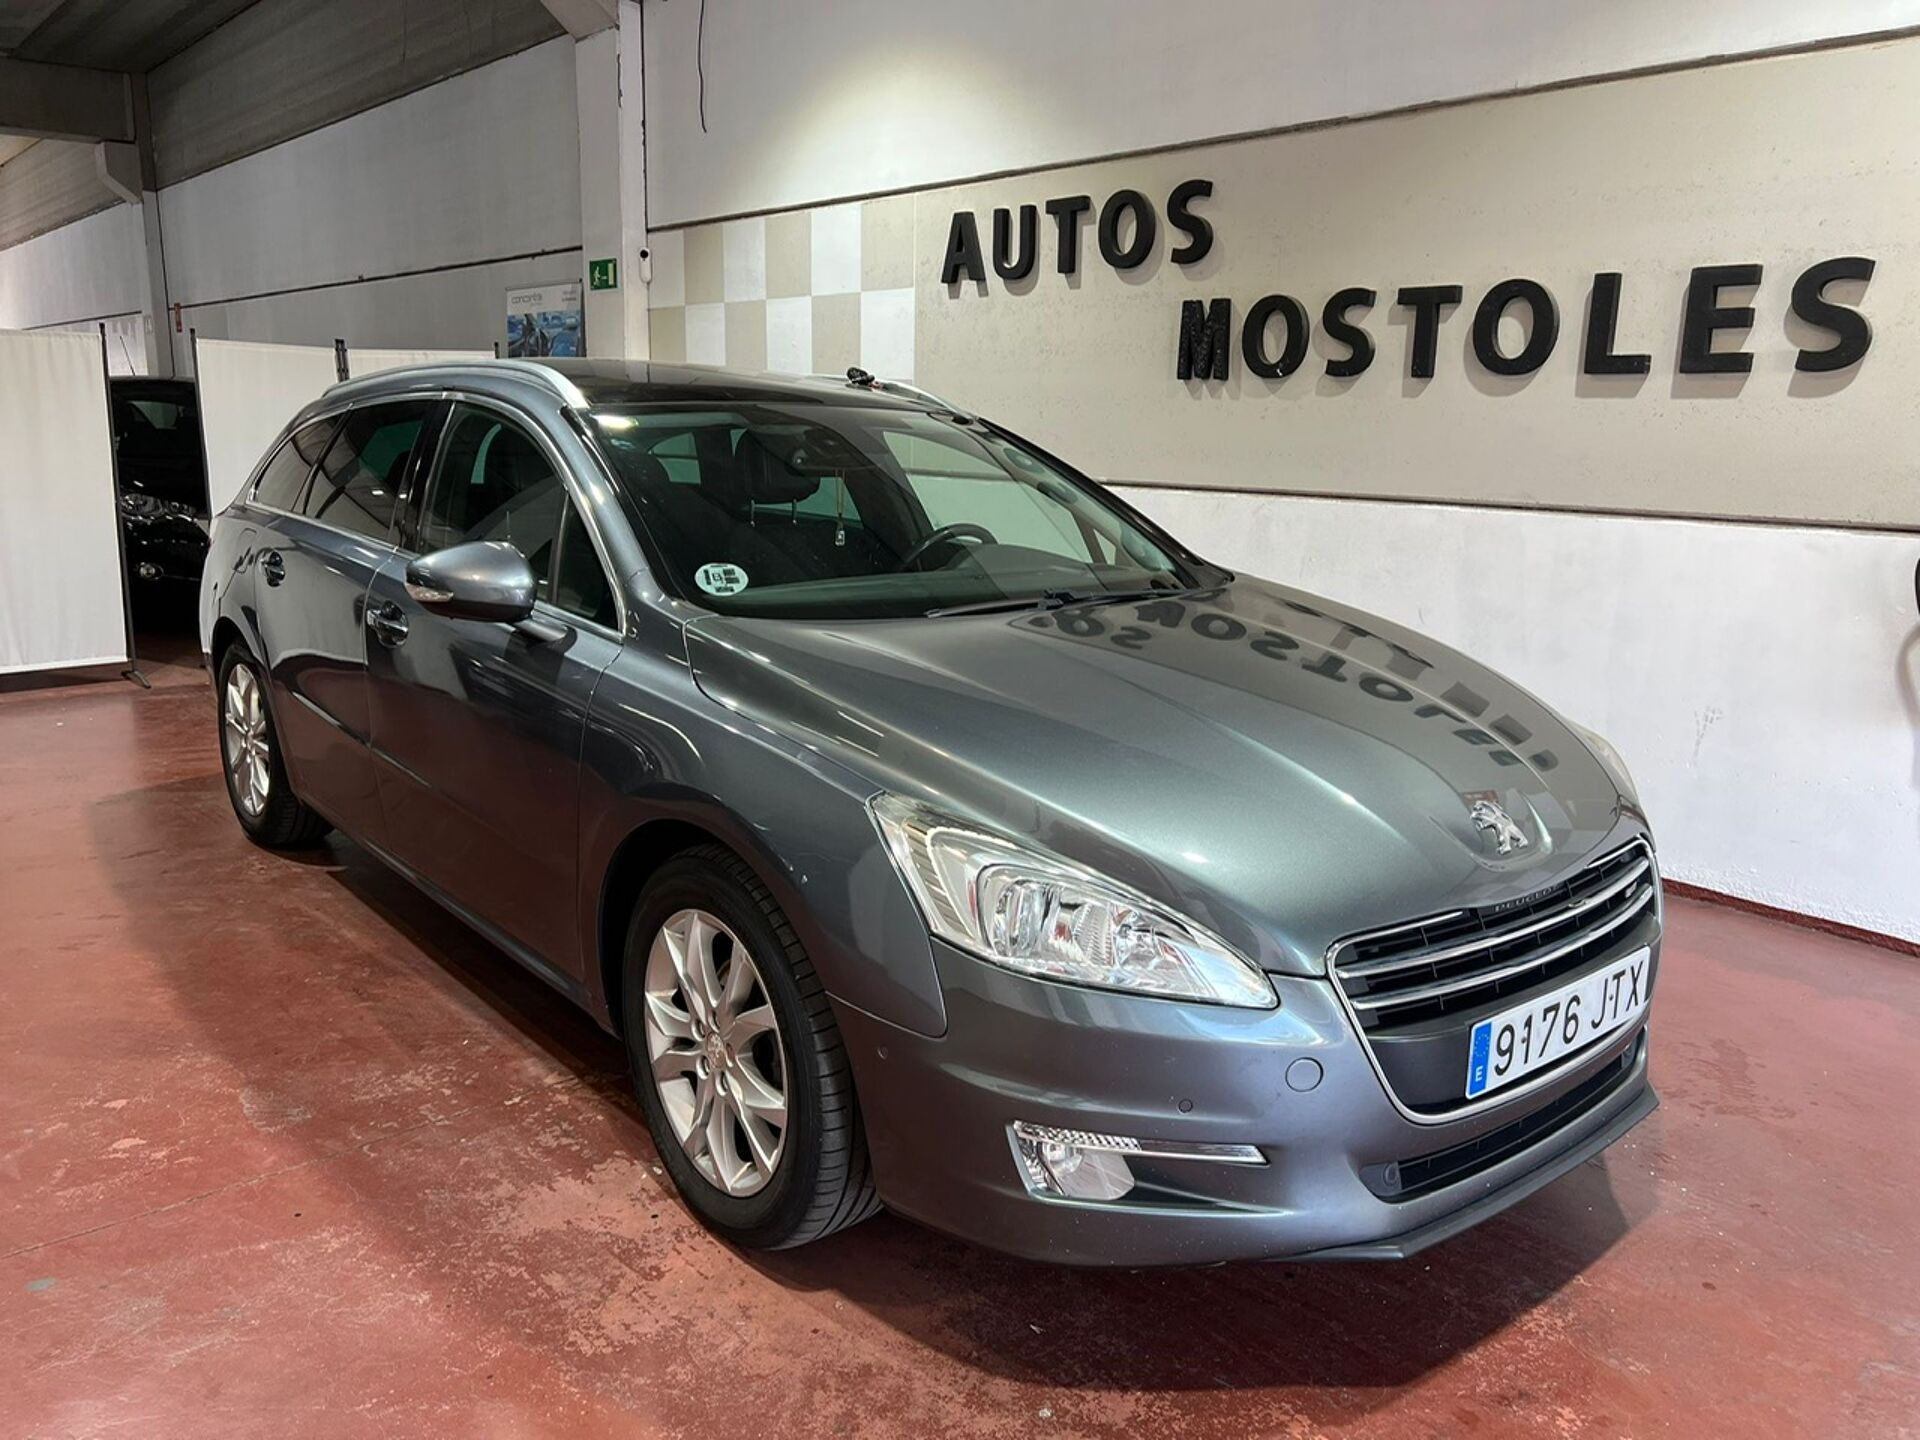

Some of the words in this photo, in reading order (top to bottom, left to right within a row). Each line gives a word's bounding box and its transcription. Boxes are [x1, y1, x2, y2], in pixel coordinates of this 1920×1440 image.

[941, 179, 1213, 283] AUTOS
[1177, 257, 1876, 380] MOSTOLES
[1494, 994, 1581, 1076] 9176
[1591, 960, 1643, 1030] JTX
[1475, 1065, 1484, 1082] E
